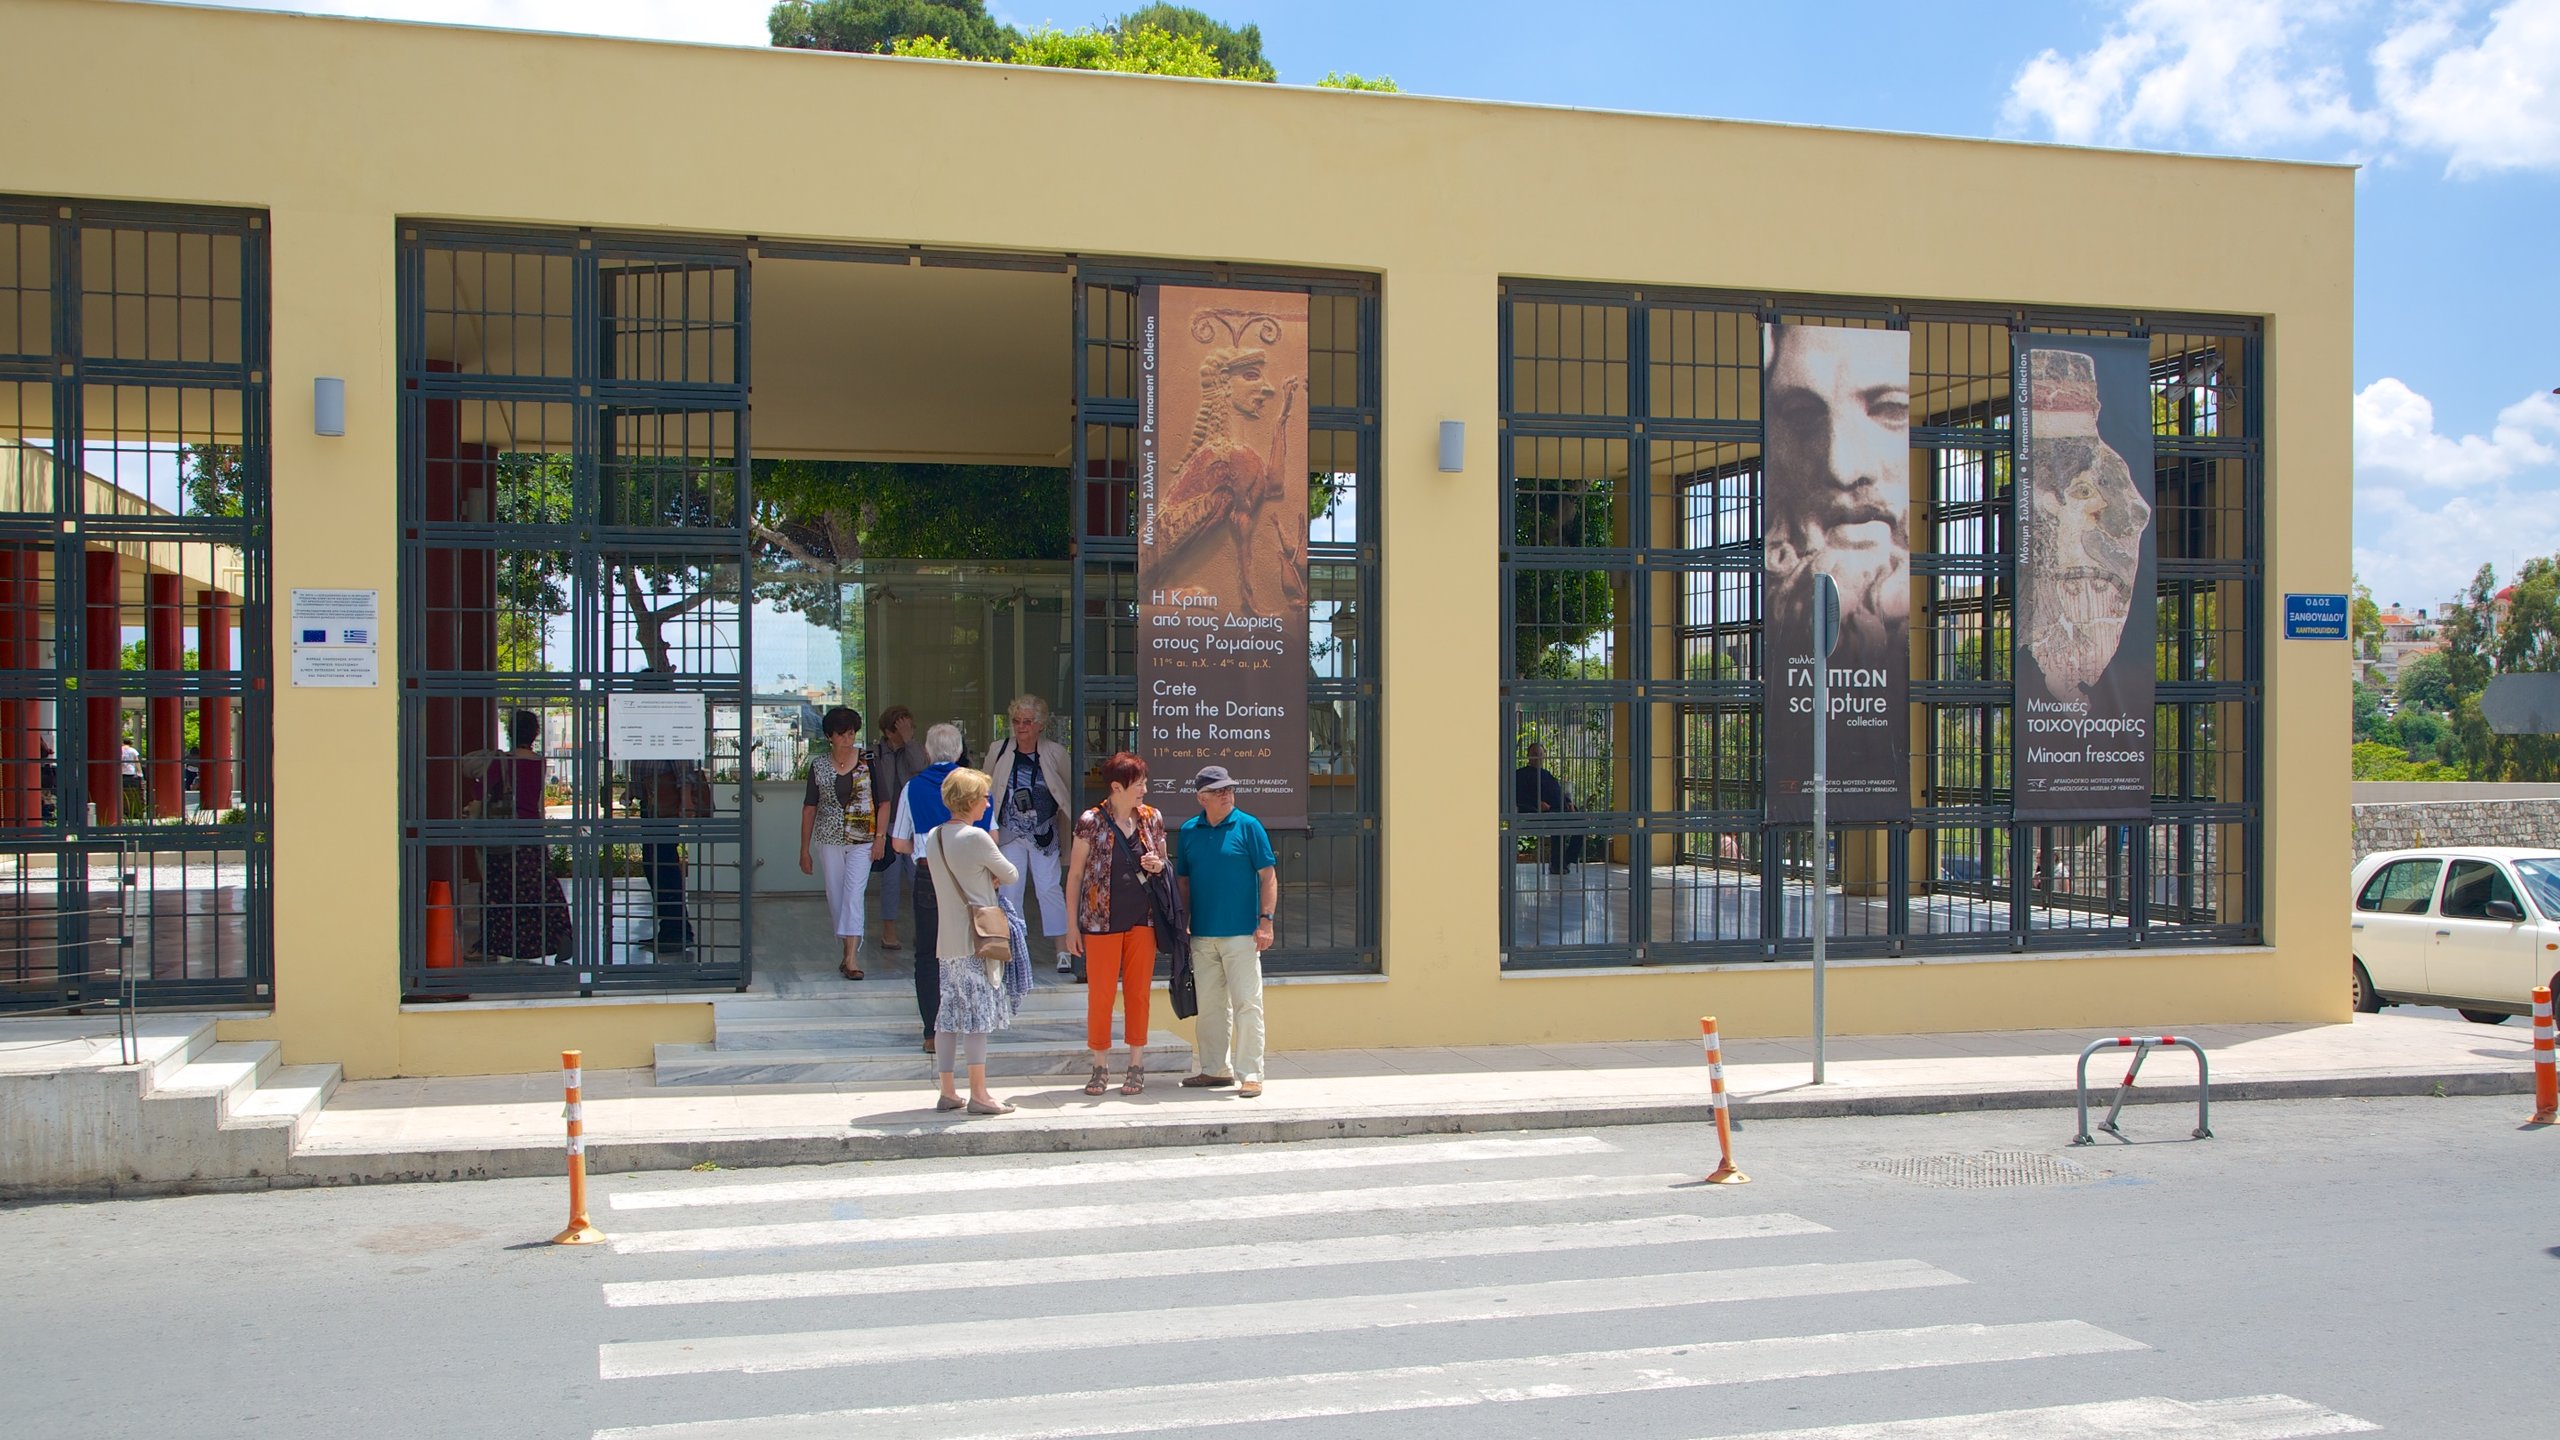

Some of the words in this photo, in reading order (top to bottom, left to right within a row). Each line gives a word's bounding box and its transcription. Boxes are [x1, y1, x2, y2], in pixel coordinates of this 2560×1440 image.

[1143, 316, 1154, 370] Collection
[2018, 353, 2028, 403] Collection
[1143, 374, 1154, 433] Permanent
[2019, 407, 2029, 460] Permanent
[1143, 451, 1156, 499] Συλλογή
[2018, 478, 2032, 522] Συλλογή
[1143, 503, 1156, 545] Μόνιμη
[2018, 525, 2032, 563] Μόνιμη
[1152, 590, 1165, 606] Η
[1171, 589, 1218, 610] Κρήτη
[2305, 598, 2330, 606] ΟΔΟΣ
[1152, 612, 1181, 627] από
[1186, 615, 1219, 631] τους
[1224, 611, 1283, 632] Δωριείς
[2289, 612, 2344, 622] ΞΑΝΘΟΥΔΙΔΟΥ
[1152, 637, 1199, 653] στους
[1206, 634, 1284, 655] Ρωμαίους
[1153, 680, 1197, 696] Crete
[1788, 668, 1887, 688] ΓΛΠΤΩΝ
[1152, 699, 1189, 717] from
[1195, 700, 1219, 717] the
[1226, 701, 1285, 717] Dorians
[1789, 687, 1887, 720] sclpture
[2027, 697, 2088, 716] Μινωικές
[1152, 725, 1169, 740] to
[1176, 723, 1201, 740] the
[1209, 724, 1271, 740] Romans
[1846, 716, 1888, 727] collection
[2027, 713, 2146, 739] τοιχογραφίες
[1153, 747, 1169, 758] 11th
[1172, 749, 1194, 758] cent.
[1197, 748, 1210, 758] BC
[1220, 747, 1231, 758] 4th
[1234, 749, 1255, 758] cent.
[1257, 748, 1271, 758] AD
[2027, 746, 2081, 763] Minoan
[2086, 744, 2145, 763] frescoes
